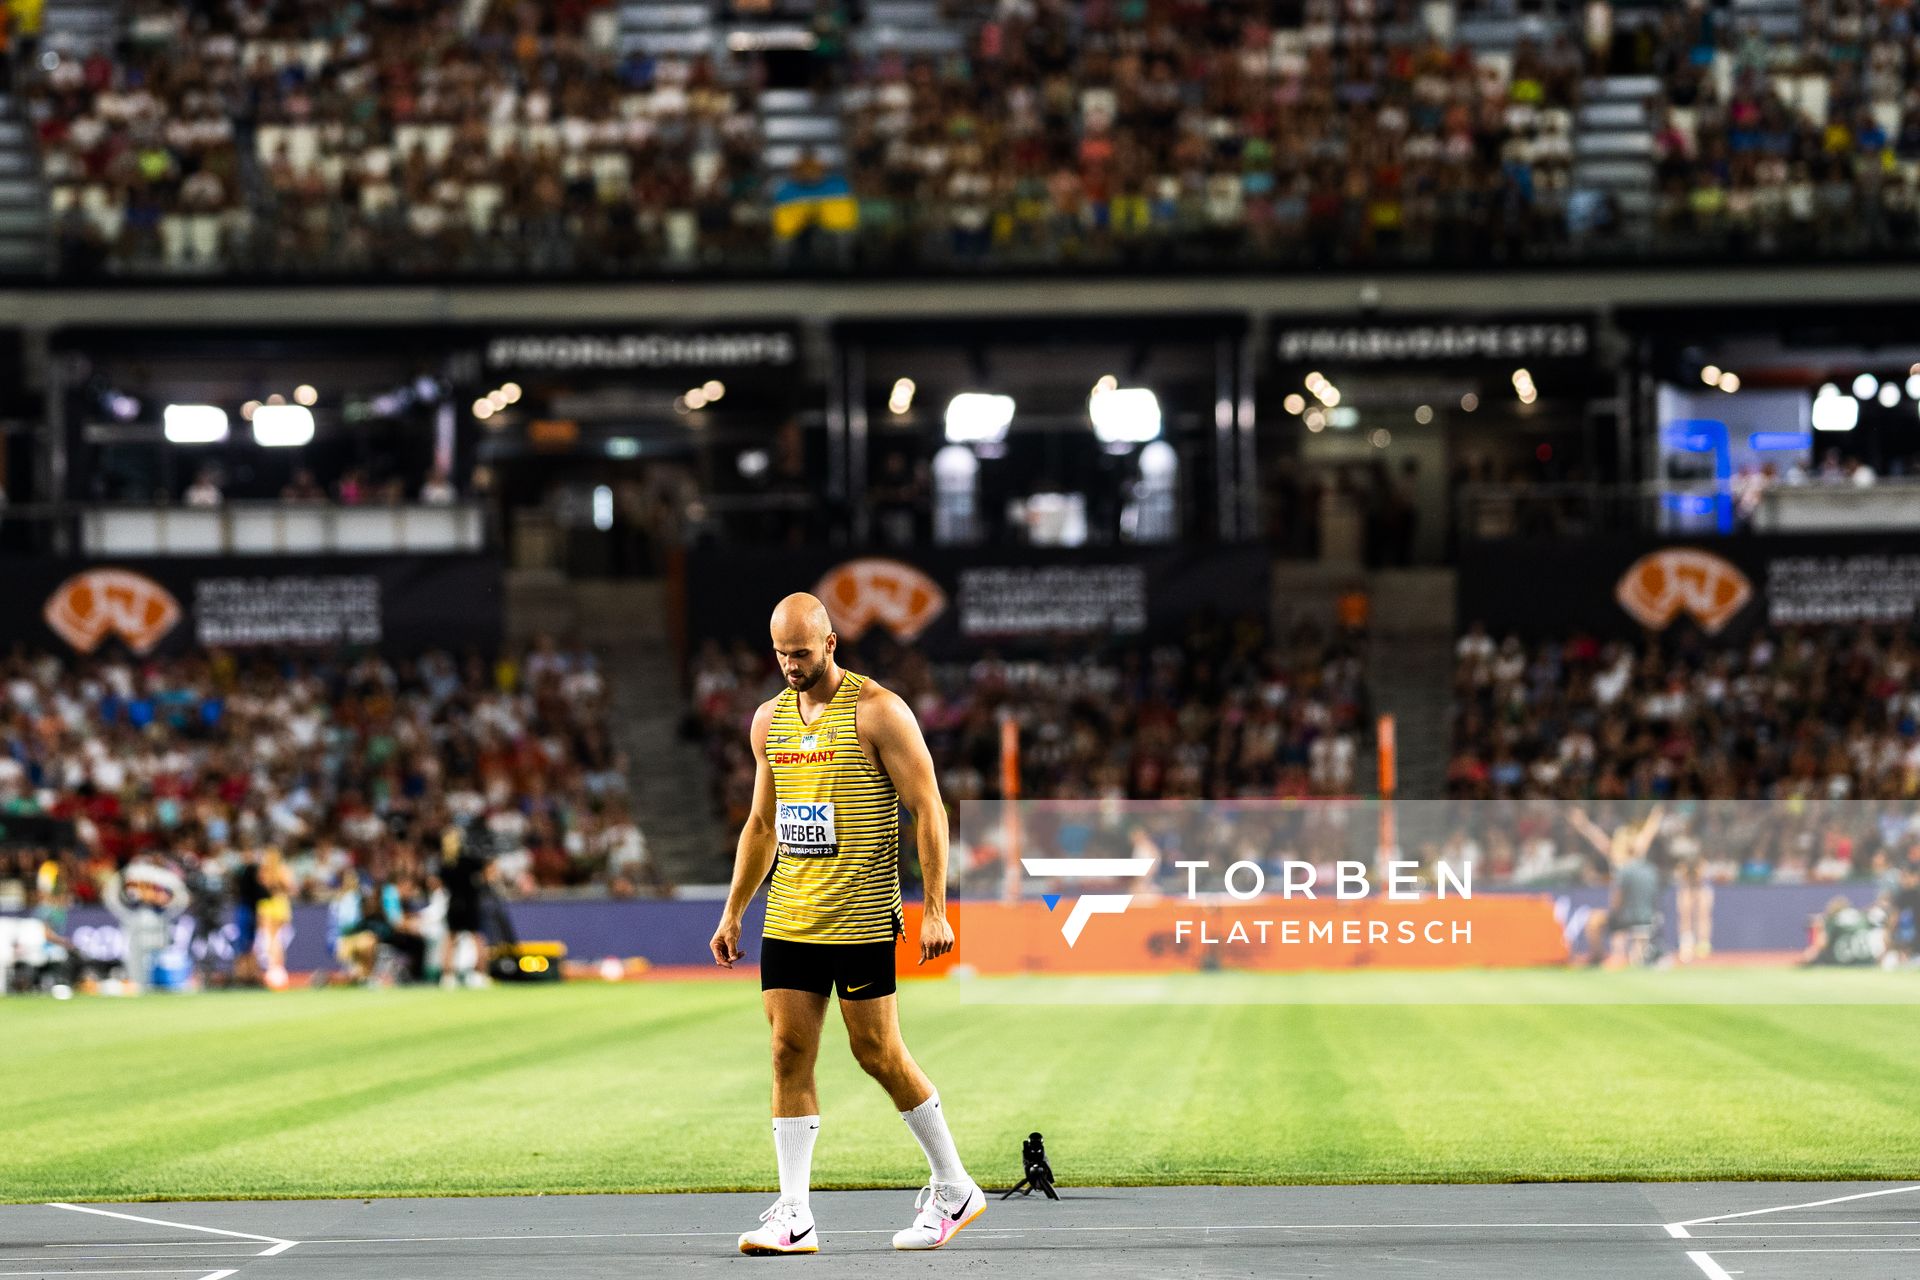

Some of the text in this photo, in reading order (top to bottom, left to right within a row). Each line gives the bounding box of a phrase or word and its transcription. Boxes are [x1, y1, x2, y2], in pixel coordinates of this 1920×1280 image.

[775, 750, 836, 764] GERMANY
[786, 805, 828, 821] TDK
[780, 824, 826, 842] WEBER
[790, 847, 823, 855] BUDAPEST
